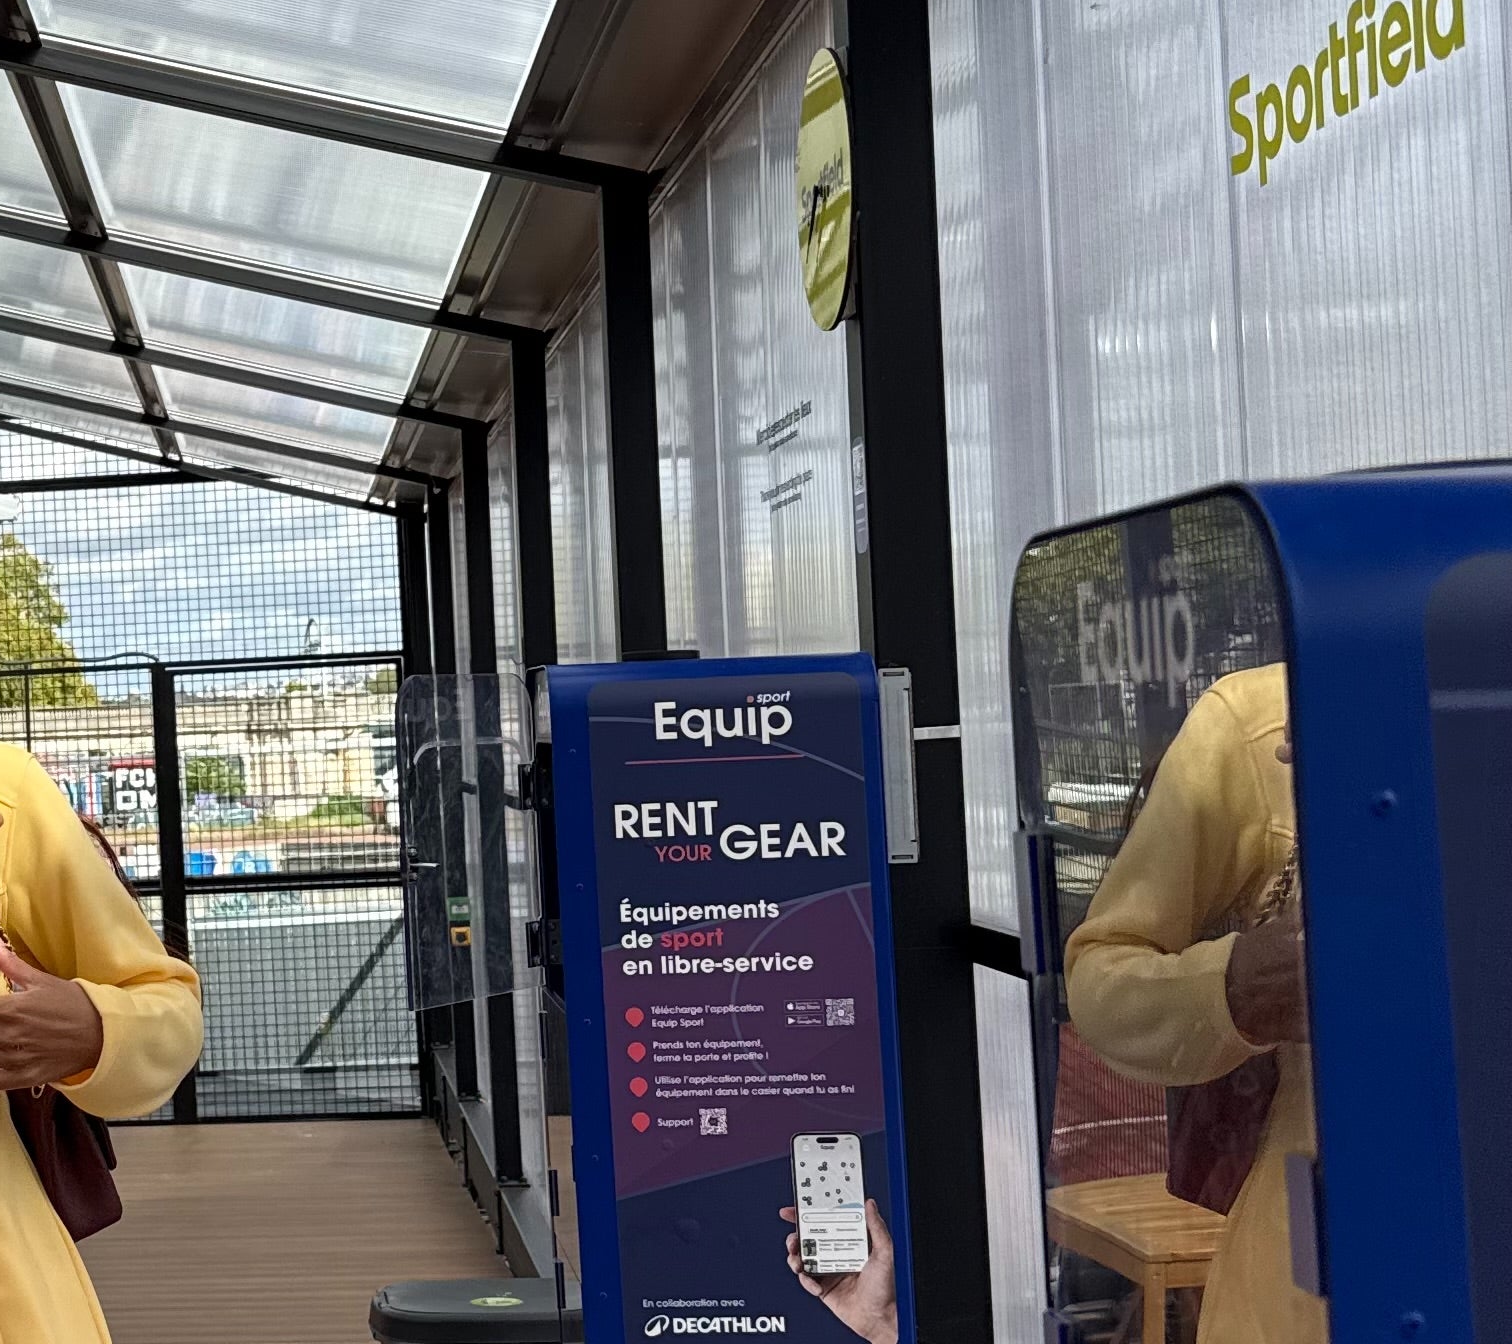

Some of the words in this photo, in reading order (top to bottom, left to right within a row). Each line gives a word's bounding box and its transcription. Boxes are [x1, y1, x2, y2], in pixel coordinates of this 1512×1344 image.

[756, 690, 791, 705] sport
[654, 697, 793, 747] Equip
[614, 800, 718, 839] RENT
[719, 822, 847, 860] GEAR
[655, 844, 712, 863] YOUR
[619, 897, 780, 926] Équipements
[621, 930, 653, 949] de
[660, 928, 723, 951] sport
[622, 959, 653, 975] en
[661, 952, 814, 974] libre-service
[651, 1004, 704, 1016] Télécharge
[652, 1019, 678, 1028] Equip
[680, 1018, 704, 1028] Sport
[653, 1041, 684, 1050] Prends
[685, 1040, 701, 1049] ton
[683, 1053, 692, 1062] la
[694, 1053, 720, 1062] porte
[721, 1053, 731, 1061] et
[744, 1075, 767, 1085] pour
[715, 1087, 738, 1096] dans
[740, 1087, 749, 1096] le
[751, 1087, 780, 1096] casier
[783, 1086, 814, 1096] quand
[657, 1117, 694, 1128] Support
[642, 1298, 654, 1308] En
[656, 1298, 719, 1308] collaboration
[720, 1299, 745, 1307] avec
[672, 1316, 786, 1334] DECATHLON
